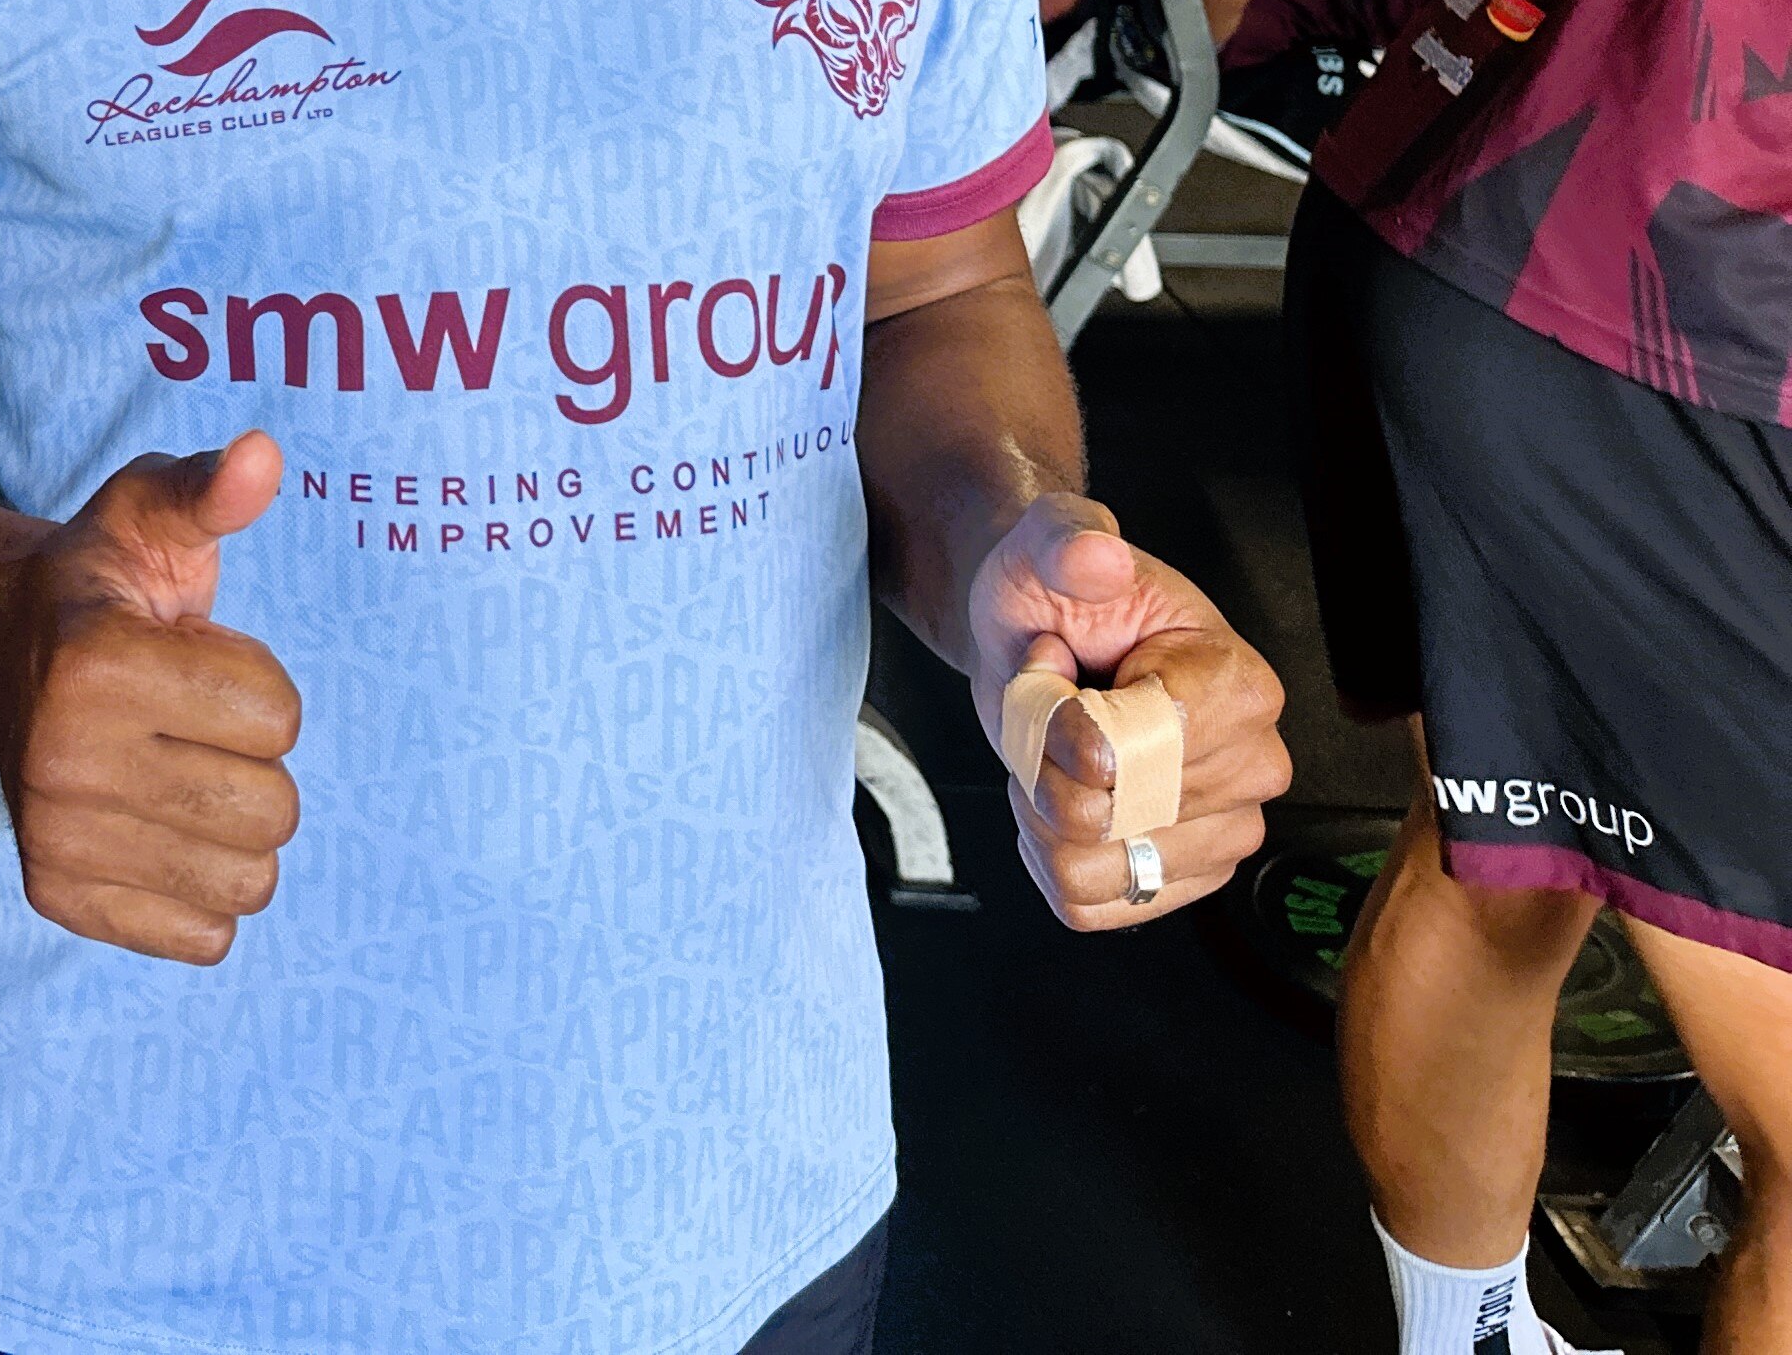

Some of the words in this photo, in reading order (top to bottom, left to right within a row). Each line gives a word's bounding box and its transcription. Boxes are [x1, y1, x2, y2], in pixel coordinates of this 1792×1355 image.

[85, 57, 402, 144] Rockhampton
[104, 119, 212, 147] LEAGUES
[222, 110, 286, 130] CLUB
[307, 106, 334, 120] LTD
[139, 286, 510, 393] smw
[302, 469, 582, 507] NEERING
[631, 425, 854, 495] CONTINUOU
[356, 491, 771, 552] IMPROVEMENT
